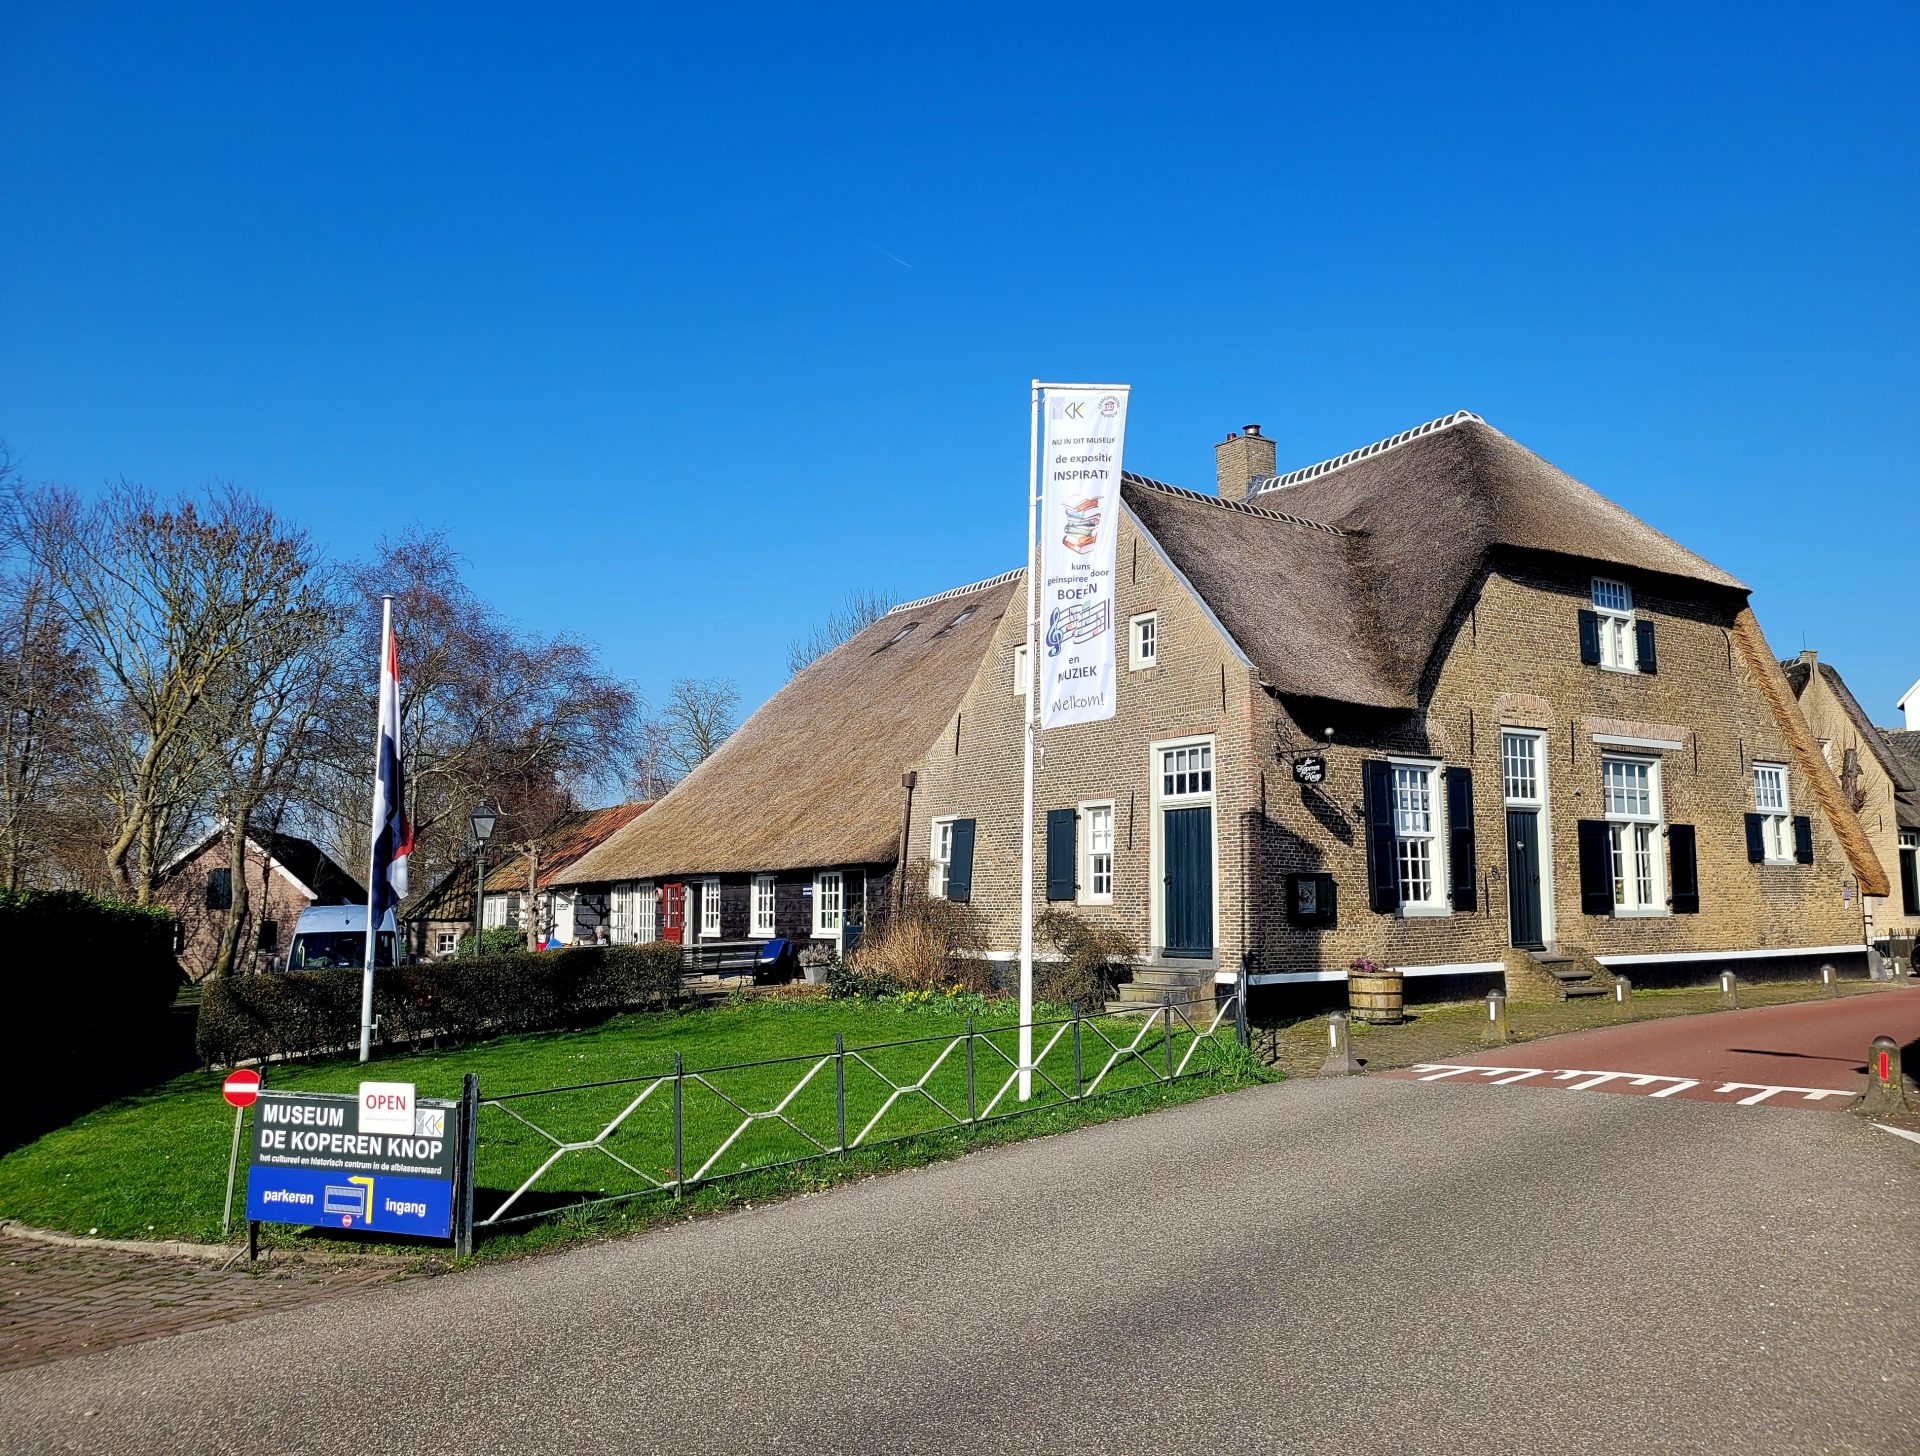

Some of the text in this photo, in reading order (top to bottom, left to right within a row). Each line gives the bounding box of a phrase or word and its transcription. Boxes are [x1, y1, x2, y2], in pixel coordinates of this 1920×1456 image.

[1055, 454, 1068, 464] de
[1071, 562, 1091, 571] kuns
[1047, 569, 1110, 587] geïnspiree door
[1068, 656, 1080, 665] en
[366, 1094, 406, 1111] OPEN
[263, 1104, 344, 1128] MUSEUM
[261, 1129, 443, 1160] DE KOPEREN KNOP
[259, 1153, 443, 1176] het cultureel en historisch centrum in de alblasserwaard
[264, 1189, 426, 1216] parkeren ingang
